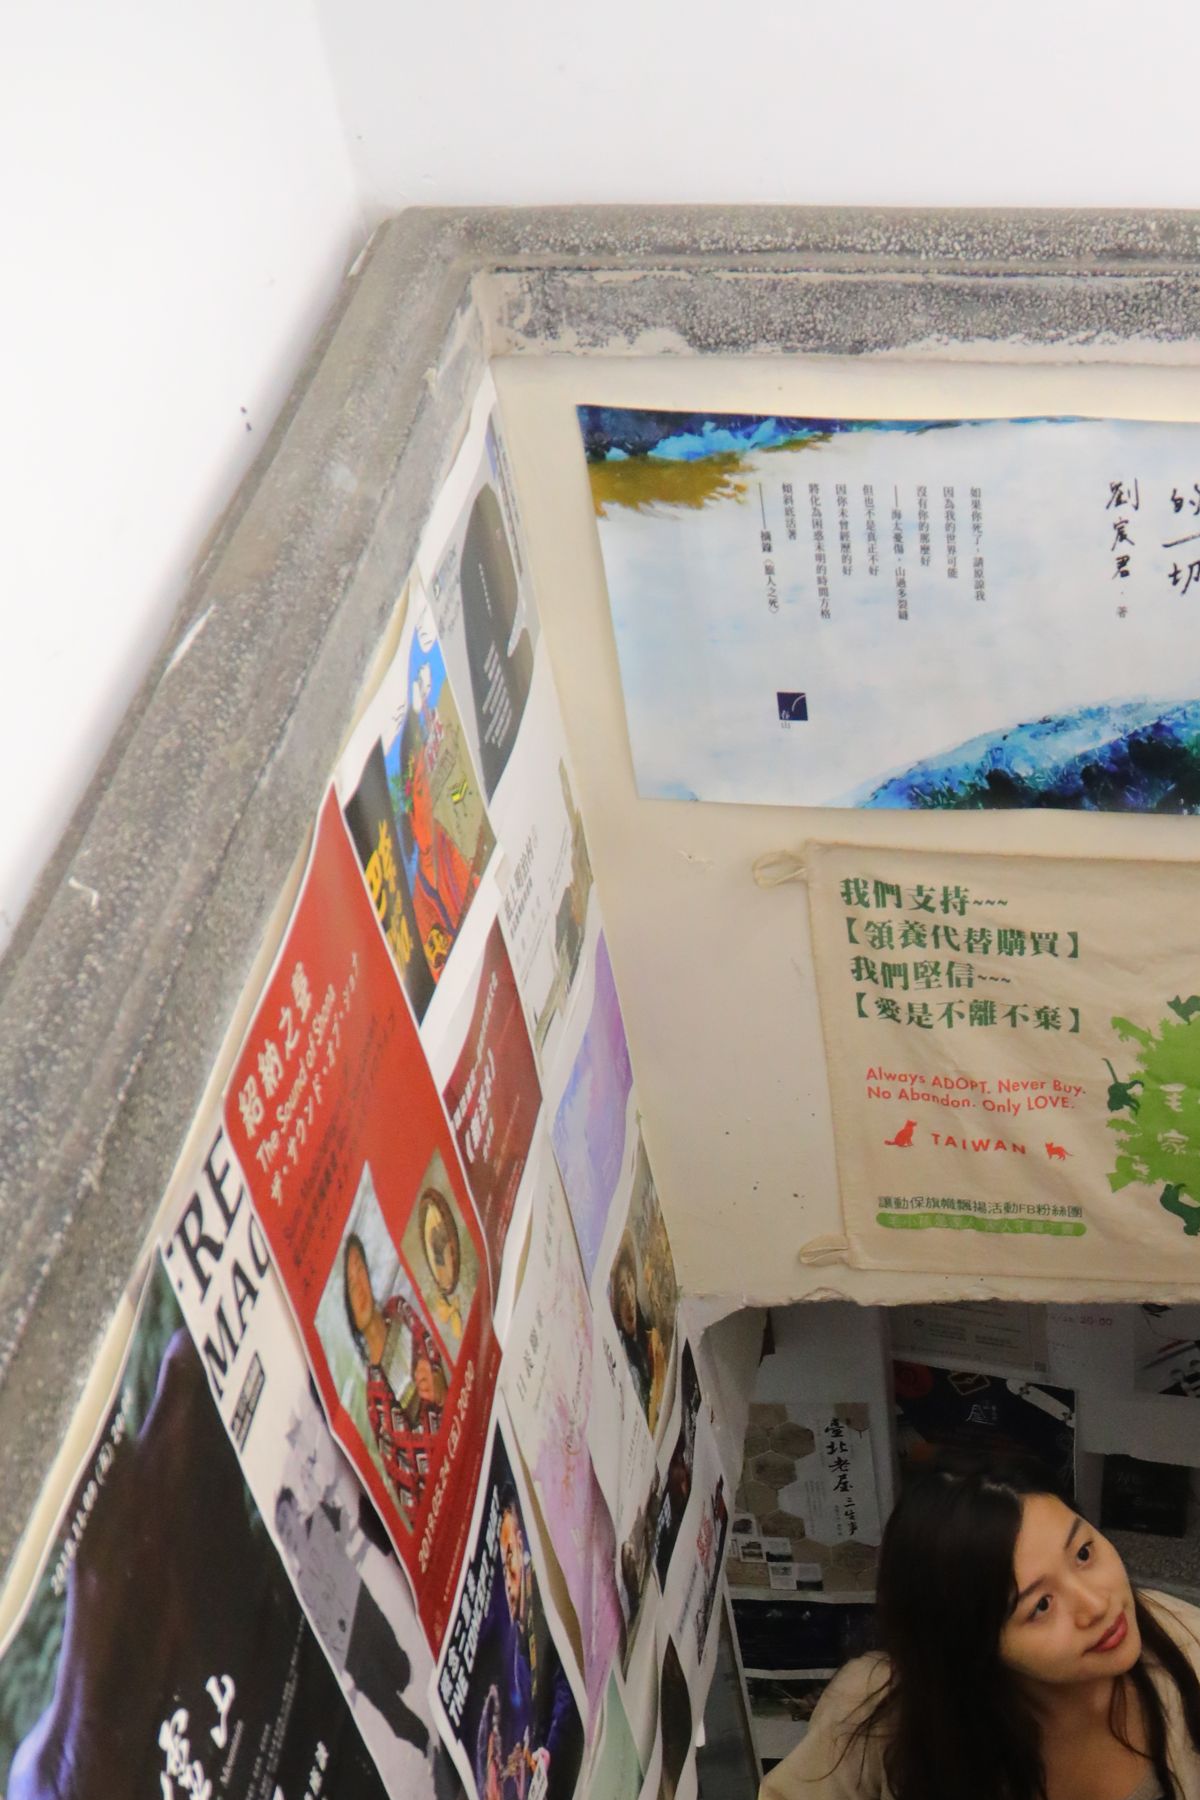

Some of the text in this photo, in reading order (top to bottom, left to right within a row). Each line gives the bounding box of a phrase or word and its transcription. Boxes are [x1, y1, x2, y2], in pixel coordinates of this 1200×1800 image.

[844, 916, 1081, 959] 【領養代替購買】
[855, 992, 1081, 1033] 【愛是不離不棄】
[866, 1066, 1087, 1098] Always ADOPT. Never Buy.
[867, 1085, 1075, 1117] No Abandon. Only LOVE.
[256, 1124, 279, 1177] The
[274, 1058, 308, 1138] Sound
[302, 1035, 318, 1072] of
[931, 1132, 1027, 1155] TAIWAN
[824, 1416, 854, 1493] 臺北老屋
[449, 1661, 469, 1727] THE
